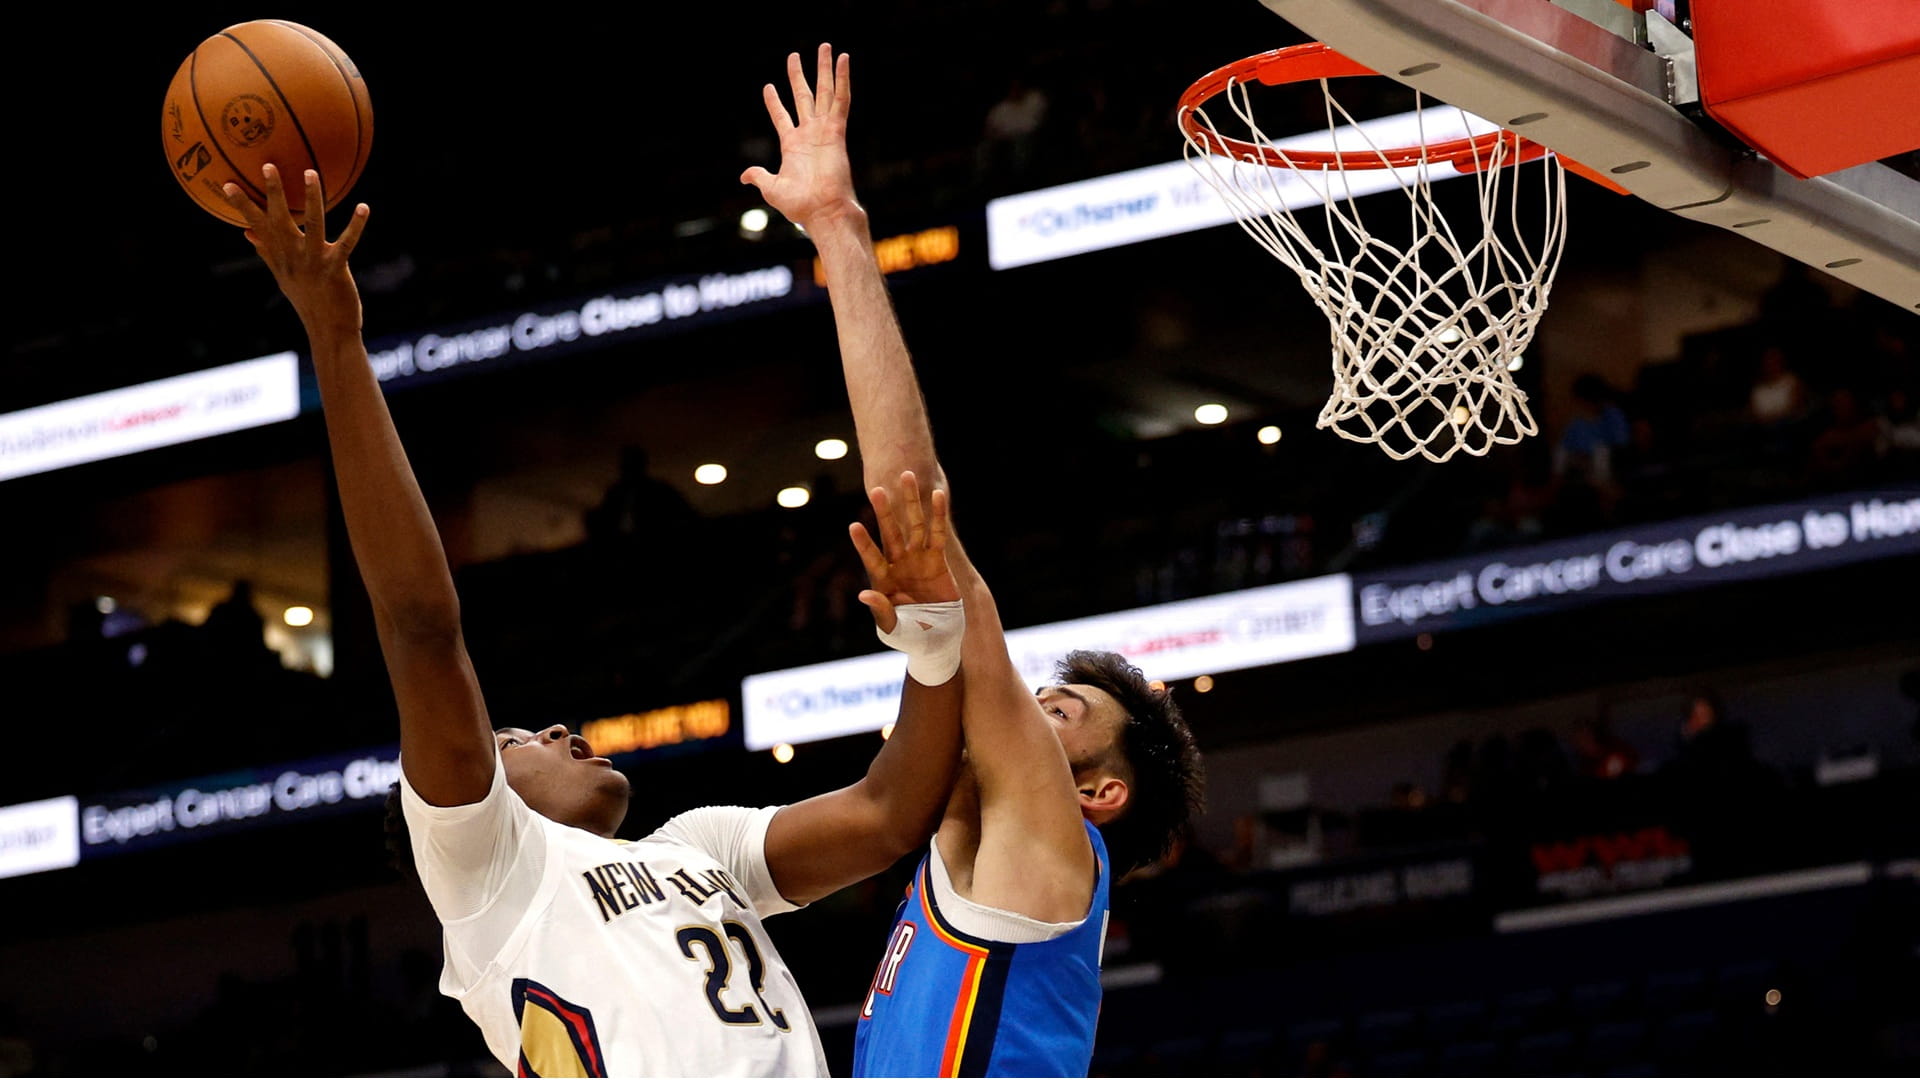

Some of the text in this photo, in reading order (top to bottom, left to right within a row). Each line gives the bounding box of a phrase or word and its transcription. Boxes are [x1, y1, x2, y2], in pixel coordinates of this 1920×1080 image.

[414, 325, 512, 372] Cancer
[511, 312, 581, 351] Care
[580, 297, 663, 336] Close
[663, 285, 700, 319] to
[699, 266, 793, 311] Home
[1360, 578, 1475, 627] Expert
[1477, 553, 1603, 604] Cancer
[1605, 540, 1695, 583] Care
[1694, 521, 1801, 567] Close
[1802, 510, 1850, 550] to
[83, 805, 175, 844] Expert
[174, 788, 273, 828] Cancer
[273, 771, 344, 811] Care
[582, 861, 667, 923] NEW
[675, 919, 792, 1033] 22
